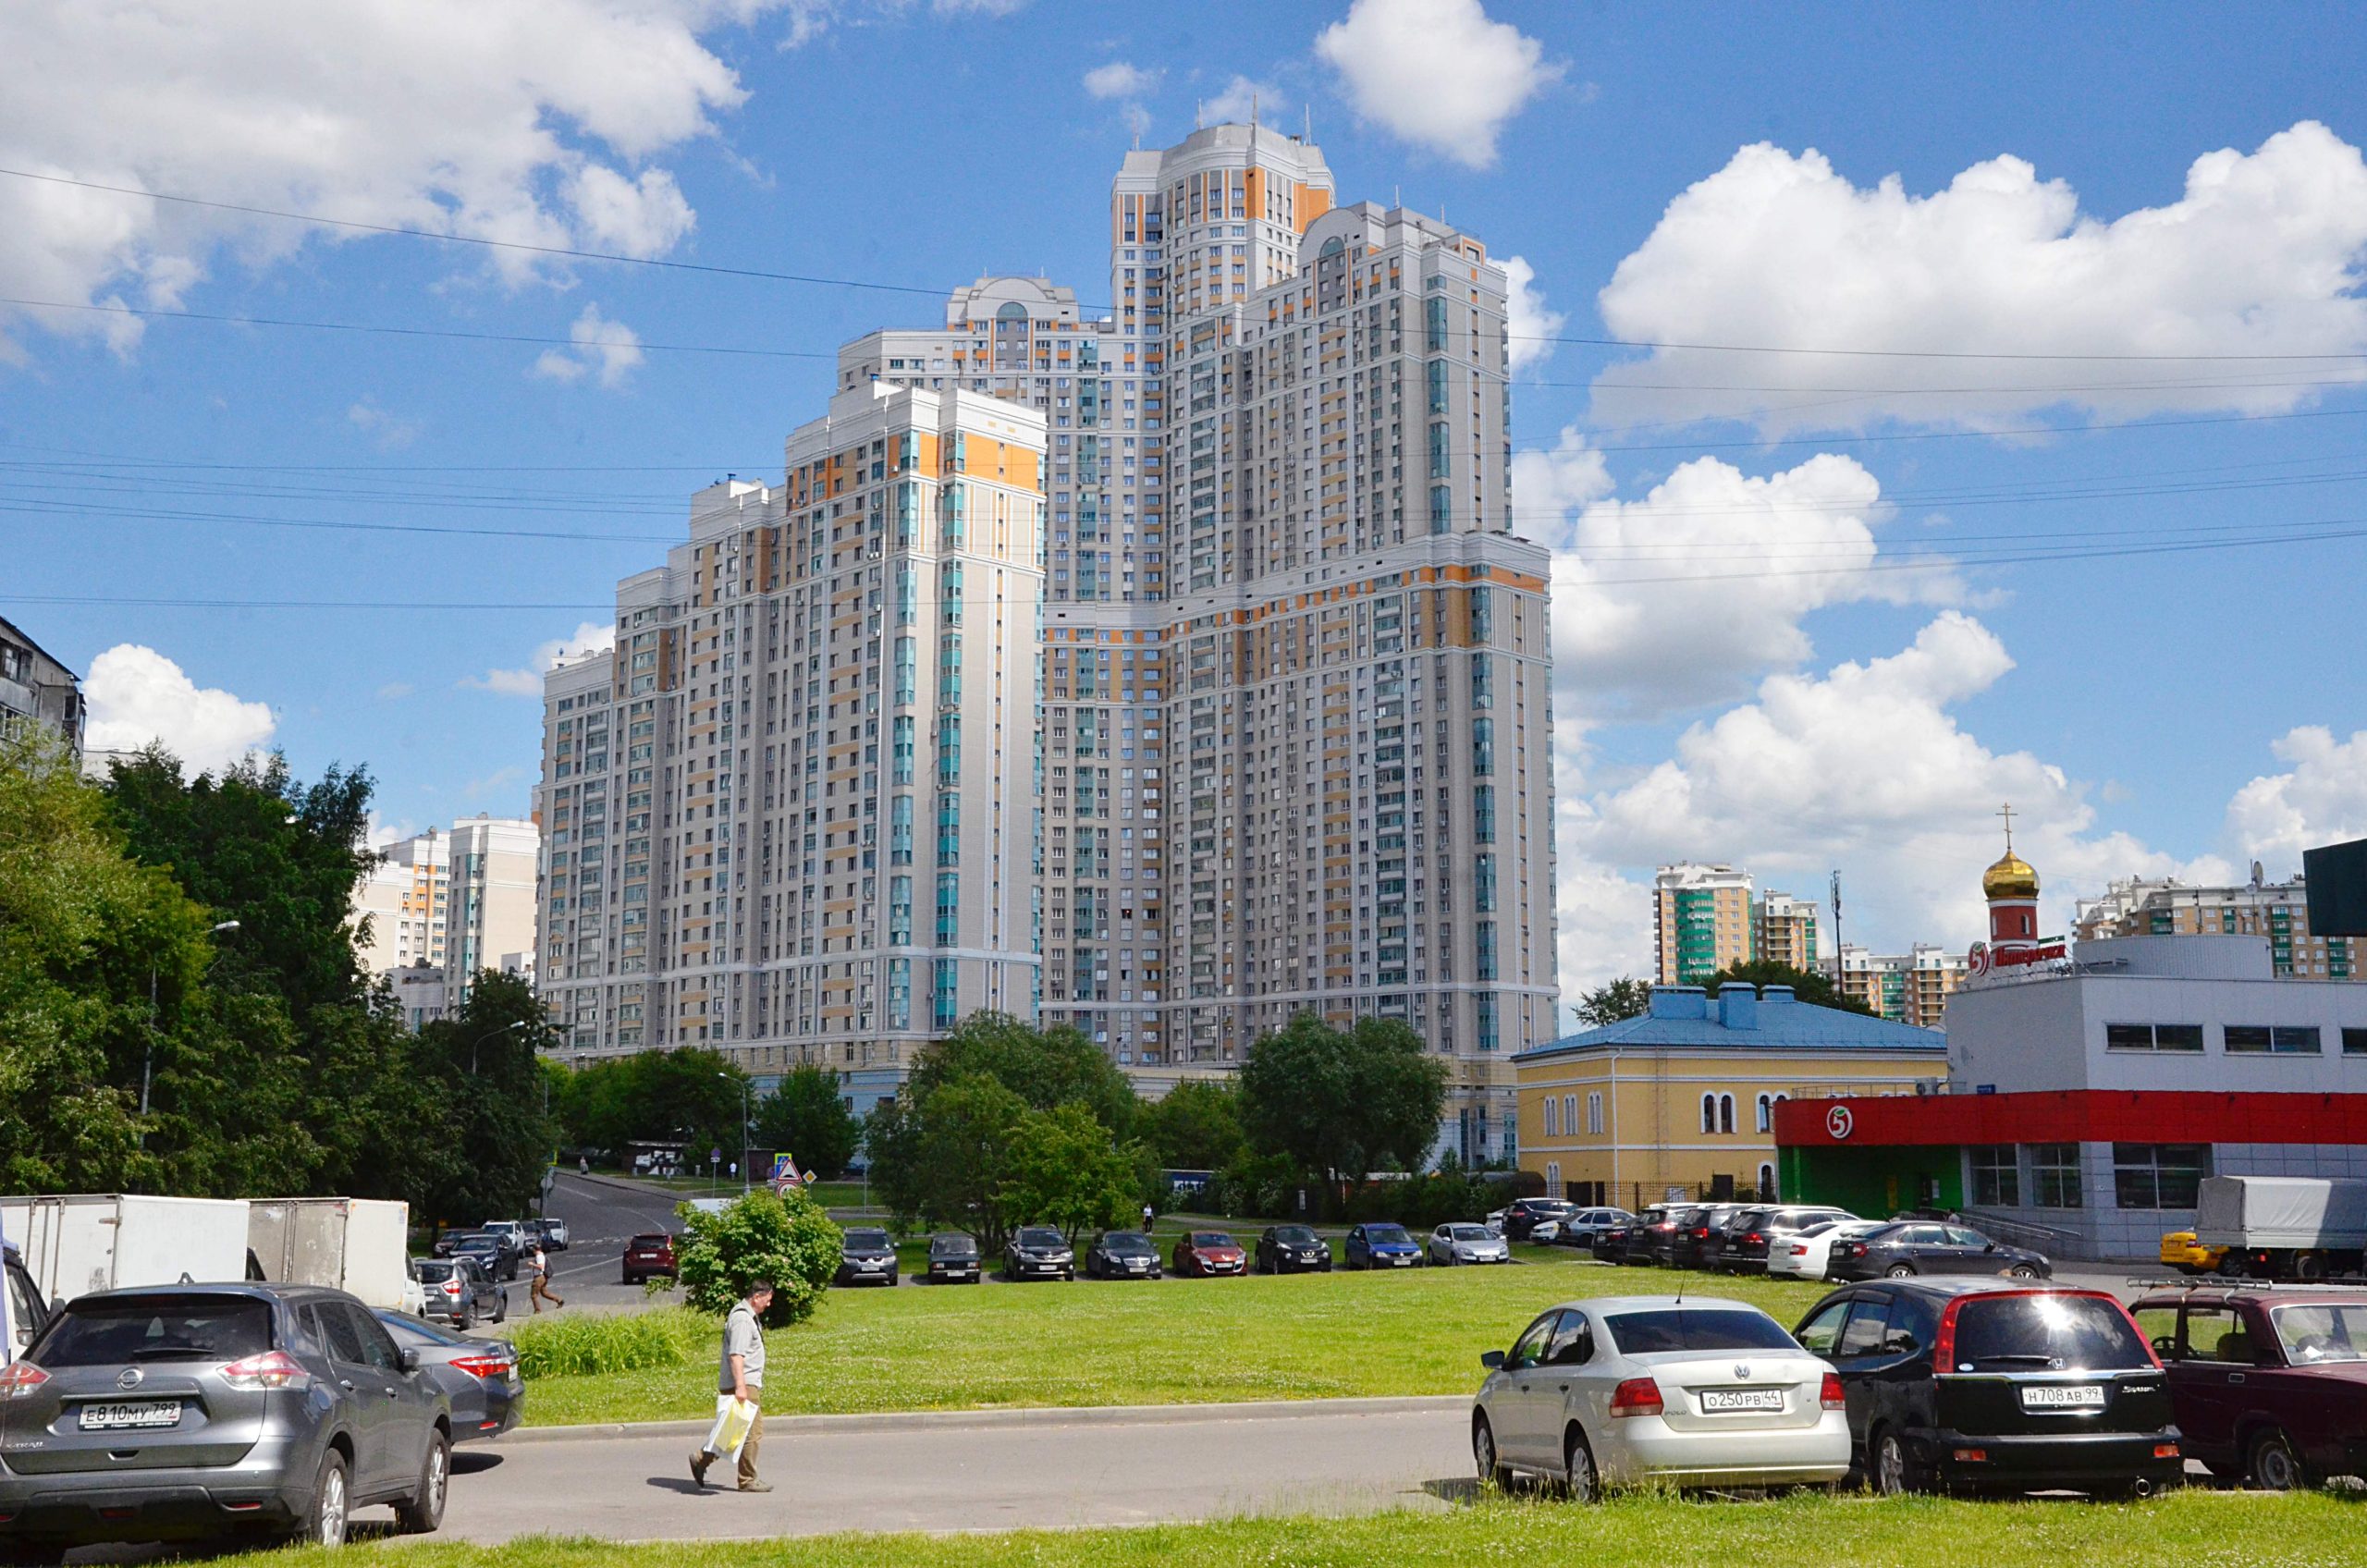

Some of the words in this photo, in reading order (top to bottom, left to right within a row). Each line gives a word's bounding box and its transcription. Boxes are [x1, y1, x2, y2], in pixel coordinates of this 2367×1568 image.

[1709, 1392, 1760, 1406] О250РВ
[1764, 1390, 1777, 1402] 44
[2086, 1388, 2098, 1397] 99
[86, 1404, 149, 1422] Е810МУ
[153, 1403, 176, 1415] 799
